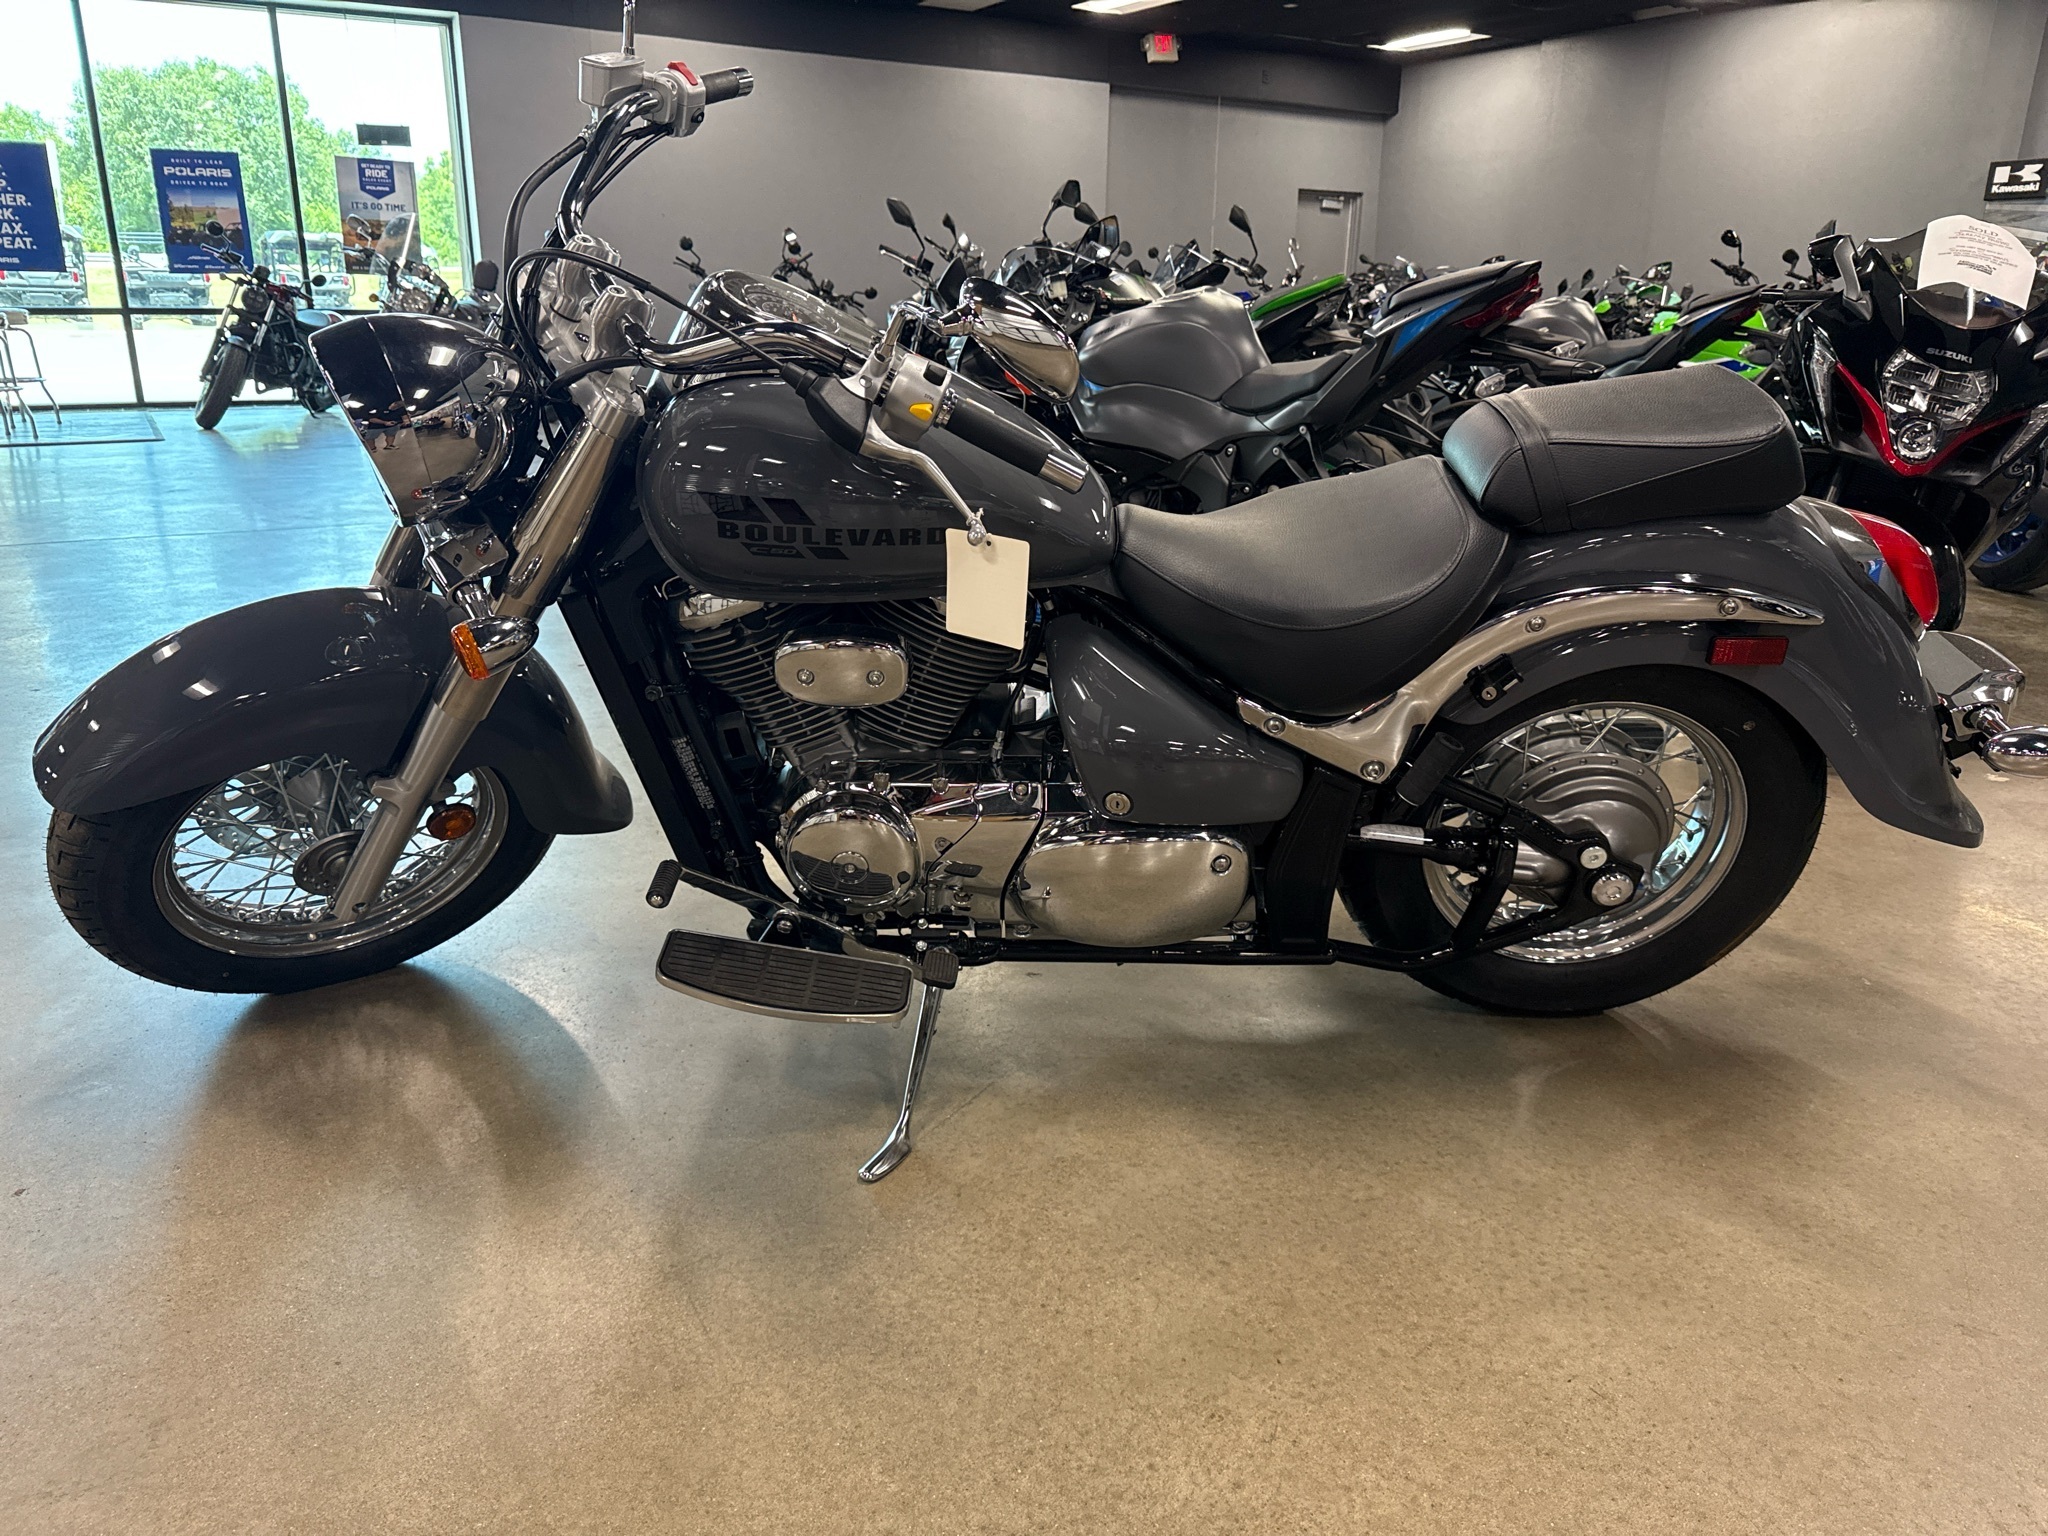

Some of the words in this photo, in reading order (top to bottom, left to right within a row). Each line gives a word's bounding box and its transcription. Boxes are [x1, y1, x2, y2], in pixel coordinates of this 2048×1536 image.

[163, 166, 232, 178] POLARIS
[364, 168, 388, 179] RIDE
[1991, 182, 2041, 194] Kawasaki
[351, 201, 369, 210] IT'S
[370, 202, 383, 211] GO
[384, 203, 406, 212] TIME
[1968, 225, 1999, 237] SOLD
[0, 236, 38, 250] EAT.
[1925, 347, 1973, 364] SUZUKI
[717, 521, 946, 547] BOULEVARD
